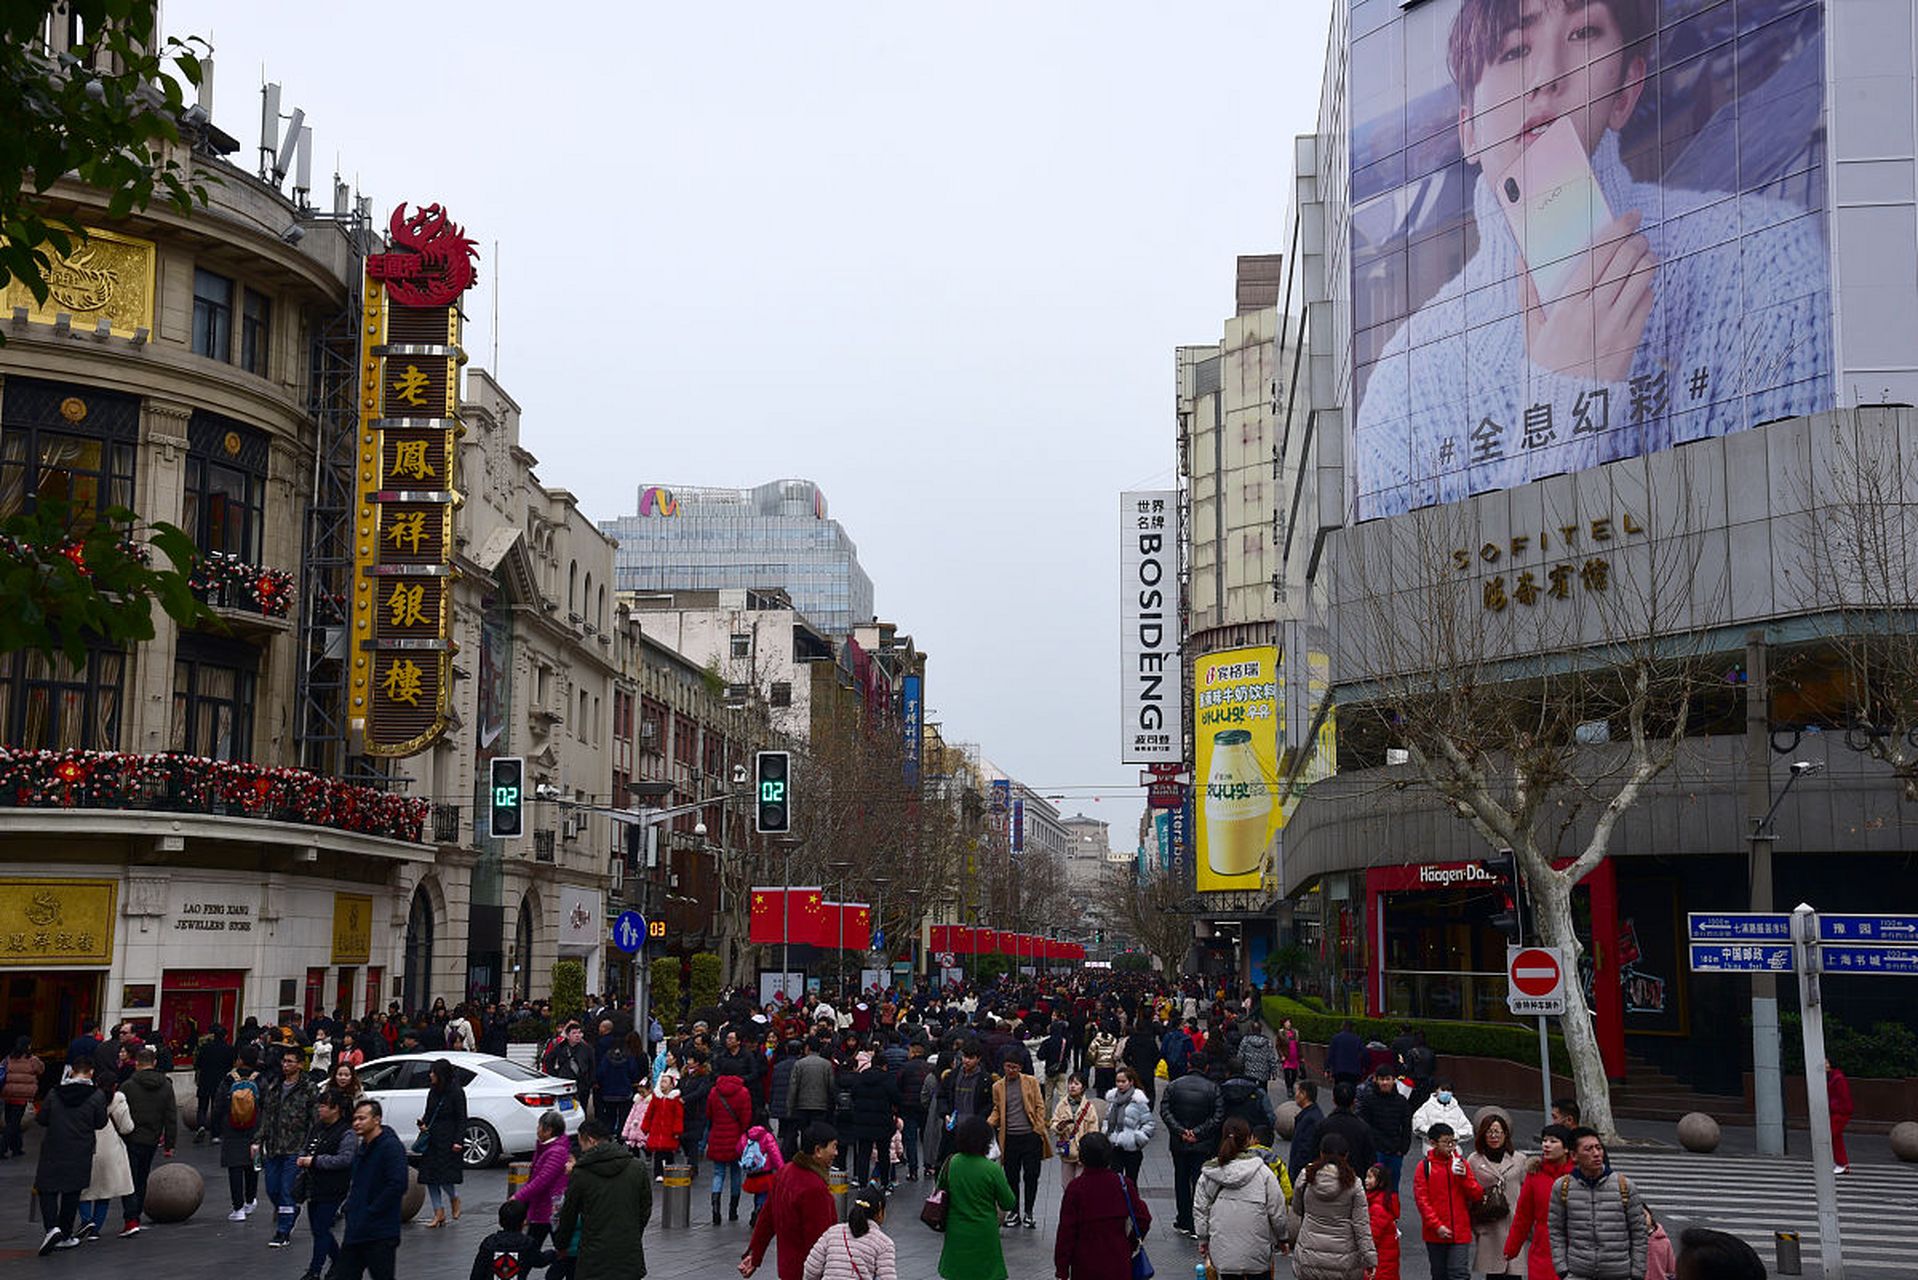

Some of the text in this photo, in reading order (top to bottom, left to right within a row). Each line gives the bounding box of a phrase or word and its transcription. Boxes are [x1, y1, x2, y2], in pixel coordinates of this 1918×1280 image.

[1137, 499, 1165, 513] 世界
[1137, 515, 1165, 530] 名牌
[382, 365, 435, 706] 老鳳祥銀樓
[1453, 513, 1644, 570] SOFITEL
[496, 787, 518, 807] 02
[762, 782, 785, 802] 02
[183, 903, 201, 914] LAO
[649, 921, 666, 937] 03
[1722, 947, 1764, 961] 中国邮政
